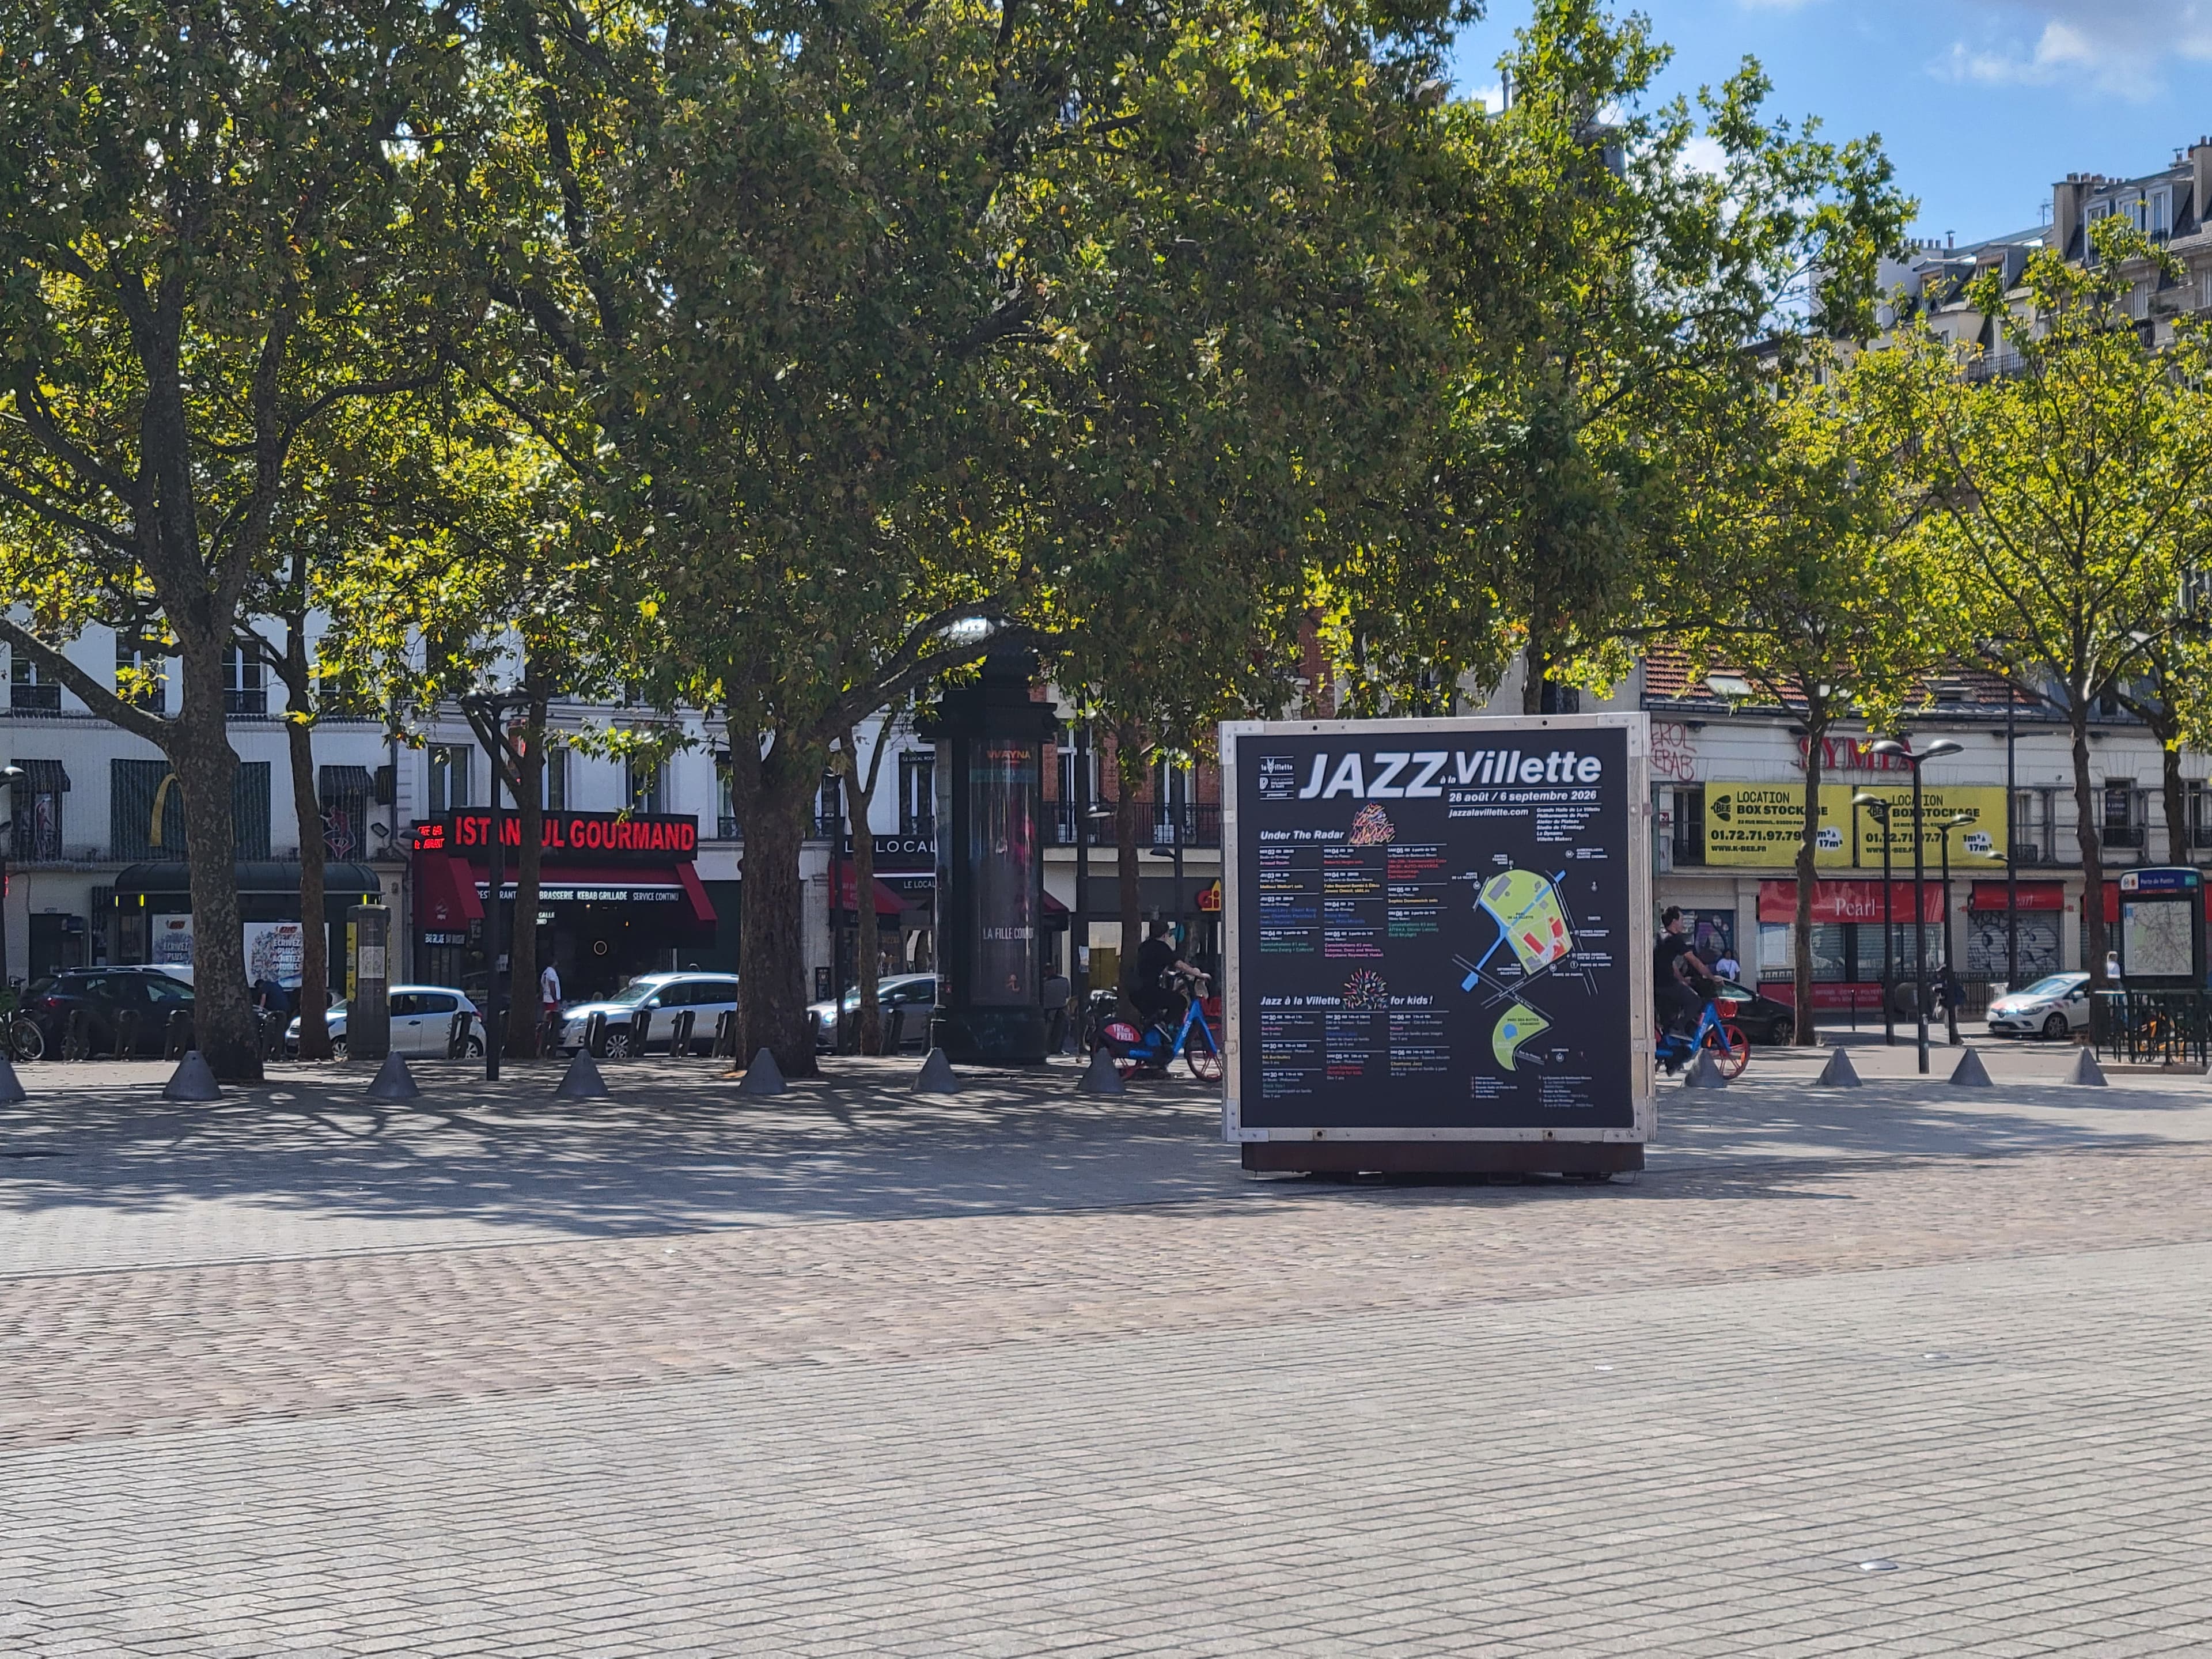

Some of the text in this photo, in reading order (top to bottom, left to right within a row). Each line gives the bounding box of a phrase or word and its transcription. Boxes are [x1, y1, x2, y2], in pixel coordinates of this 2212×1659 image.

[1299, 750, 1602, 800] JAZZ à la Villette
[1449, 790, 1597, 803] 28 août / 6 septembre 2026
[1737, 791, 1790, 804] LOCATION
[1448, 808, 1529, 819] jazzalavillette.com
[1737, 805, 1828, 816] BOX STOCKE
[454, 816, 565, 848] ISTNUL
[569, 819, 695, 851] GOURMAND
[1260, 830, 1345, 840] Under The Radar
[1711, 830, 1801, 841] 01.72.71.97.79
[875, 840, 937, 853] LOCAL
[903, 880, 937, 889] LE LOCAL
[539, 891, 574, 900] BRASSERIE
[577, 891, 597, 900] KEBAB
[599, 891, 627, 900] GRILLADE
[632, 892, 654, 901] SERVICE
[656, 892, 679, 901] CONTINU
[1835, 898, 1876, 916] Pearl
[983, 927, 993, 940] LA
[995, 927, 1012, 940] FILLE
[1260, 997, 1282, 1005] Jazz
[1285, 996, 1291, 1005] à
[1294, 997, 1303, 1005] la
[1306, 997, 1341, 1005] Villette
[1391, 996, 1405, 1005] for
